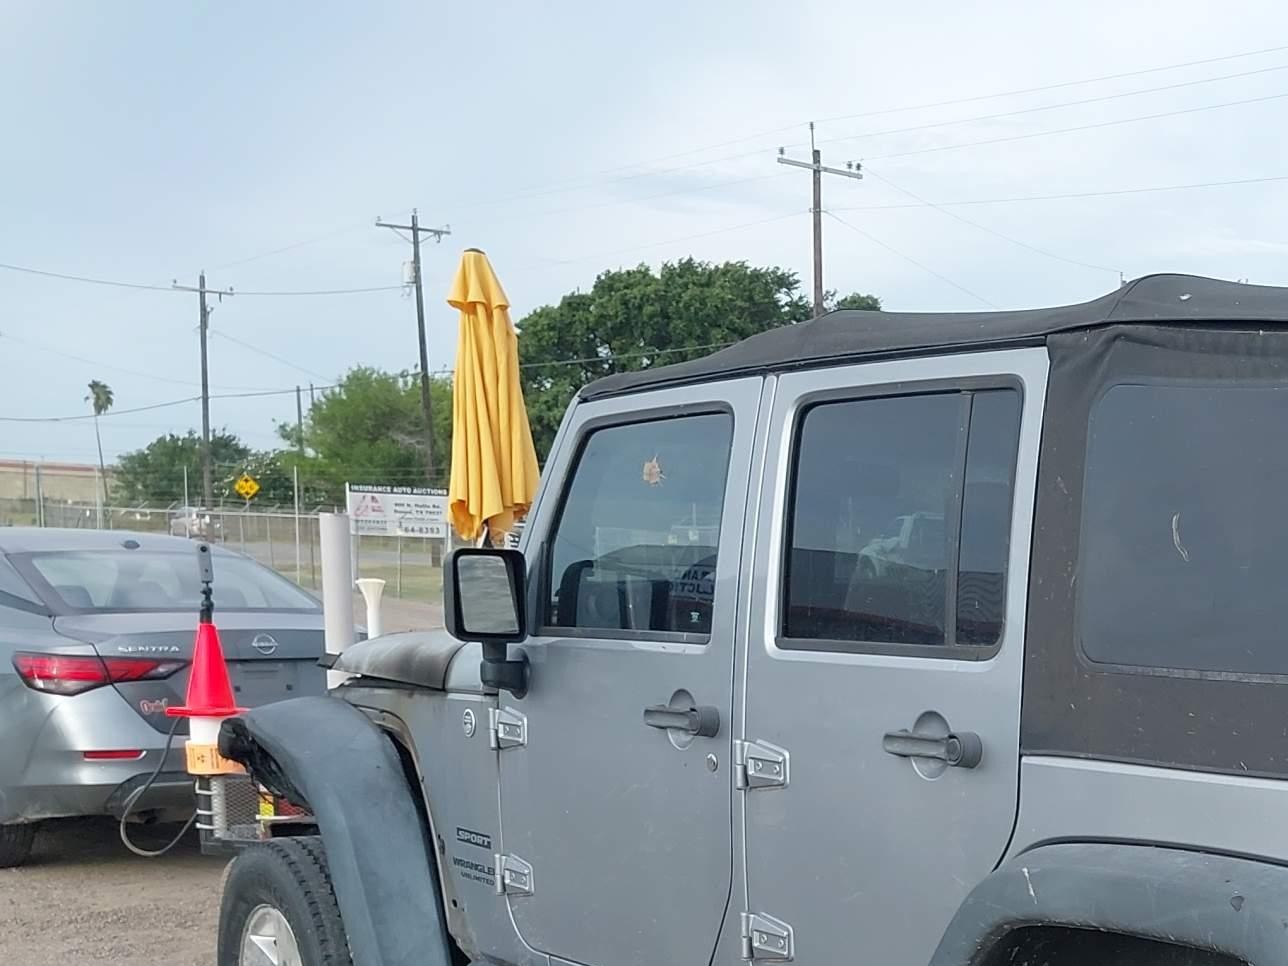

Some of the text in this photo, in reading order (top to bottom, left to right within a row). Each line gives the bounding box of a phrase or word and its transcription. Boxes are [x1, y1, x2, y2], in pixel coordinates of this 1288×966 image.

[351, 485, 391, 493] INSURANCE
[117, 645, 180, 653] SENTRA
[457, 829, 491, 847] SPORT
[461, 871, 496, 887] UNLIMITED
